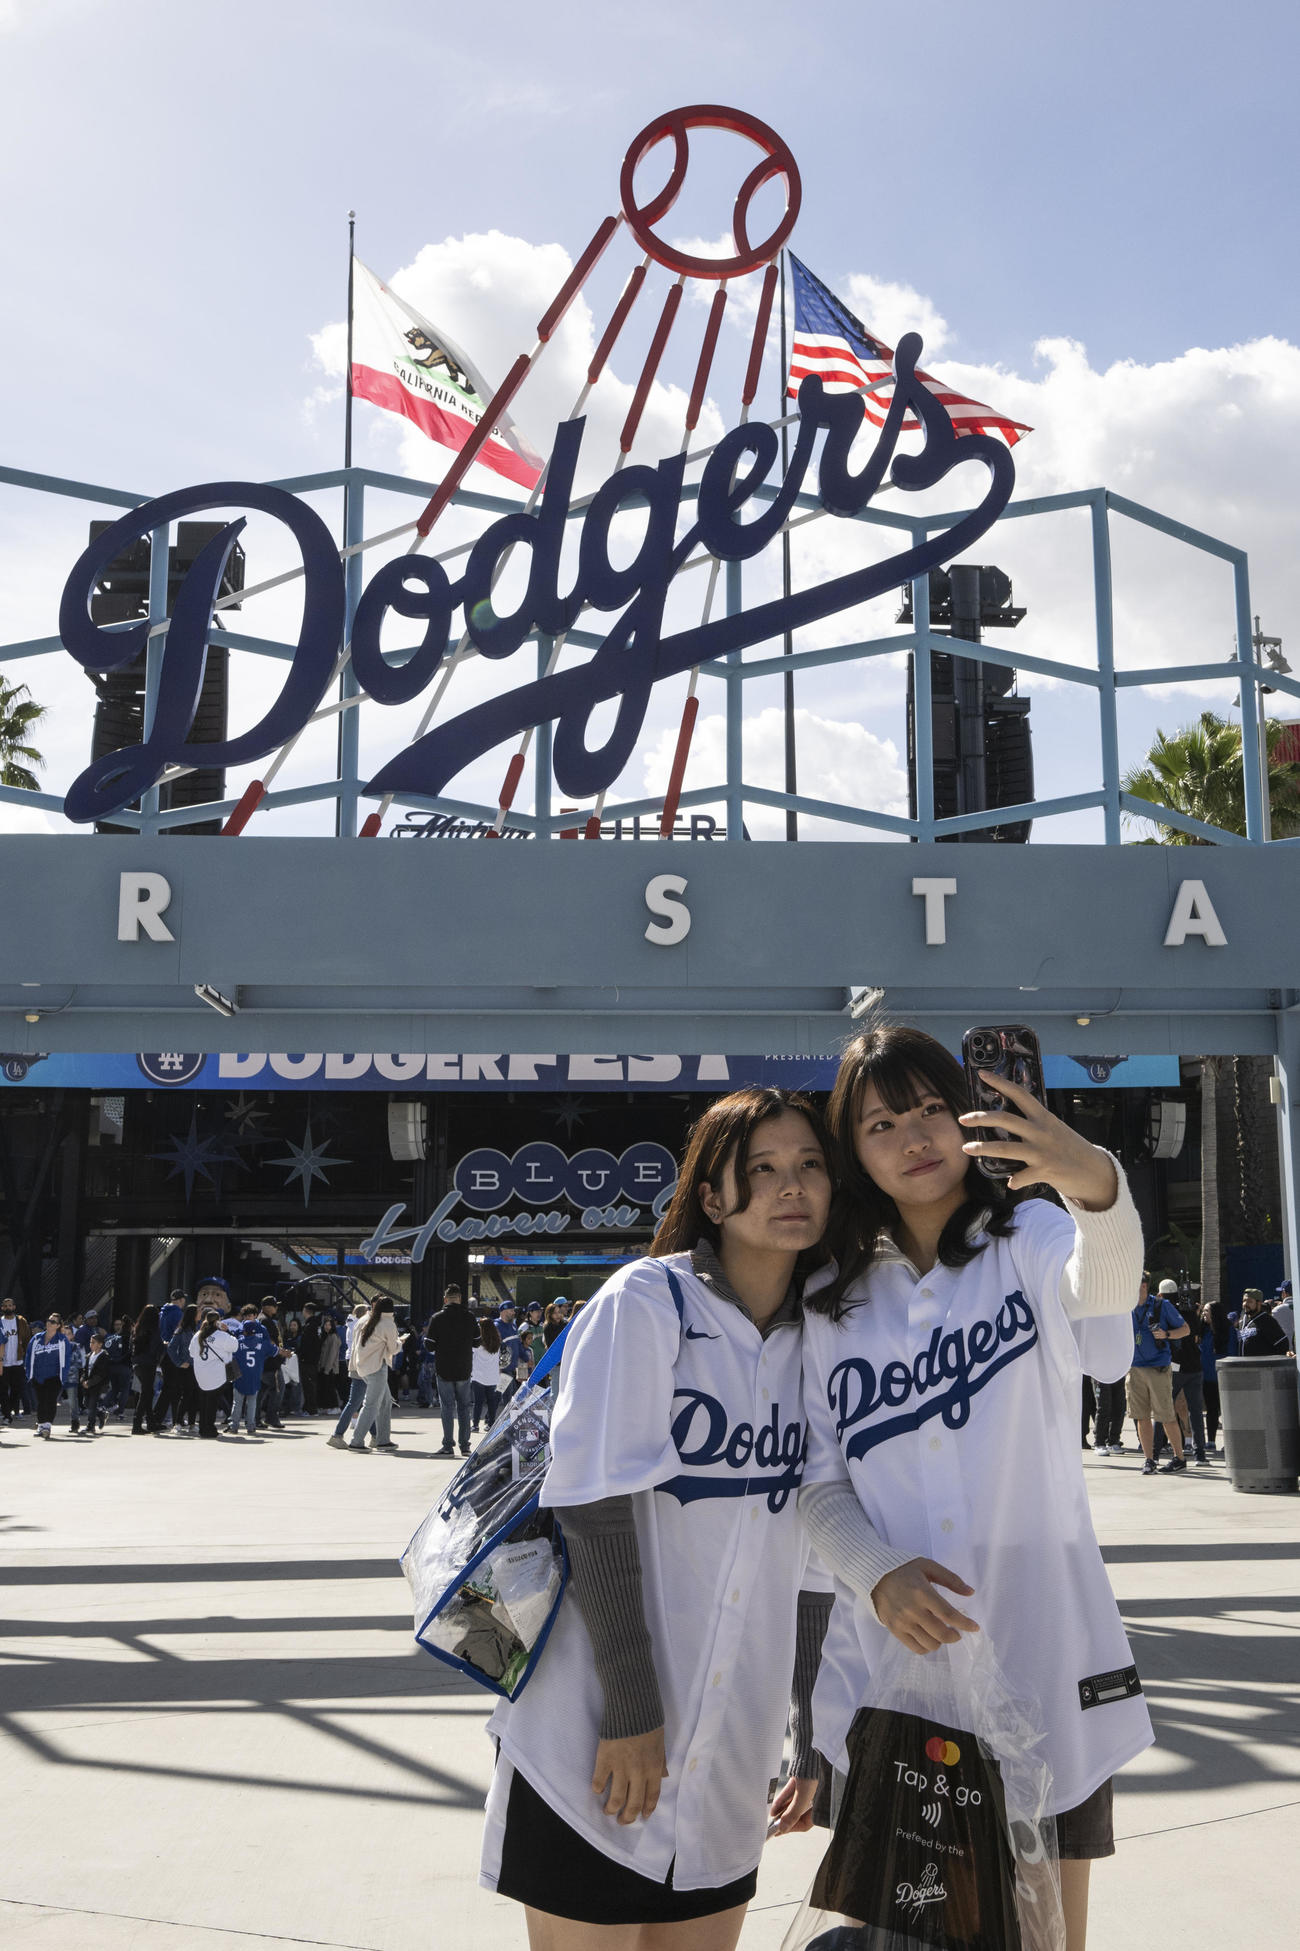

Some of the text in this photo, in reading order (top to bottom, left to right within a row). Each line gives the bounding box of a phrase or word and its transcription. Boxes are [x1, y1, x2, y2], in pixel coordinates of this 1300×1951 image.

[393, 361, 457, 406] CALIFRNIA
[59, 332, 1016, 824] Dodgers
[470, 1162, 662, 1191] BLUE
[359, 1190, 571, 1264] Heaven
[580, 1206, 640, 1231] on
[245, 1351, 257, 1368] 5
[827, 1290, 1039, 1463] Dodgers
[670, 1388, 808, 1514] Dodg
[894, 1761, 982, 1806] Tap & go
[935, 1840, 947, 1853] by
[948, 1844, 965, 1857] the
